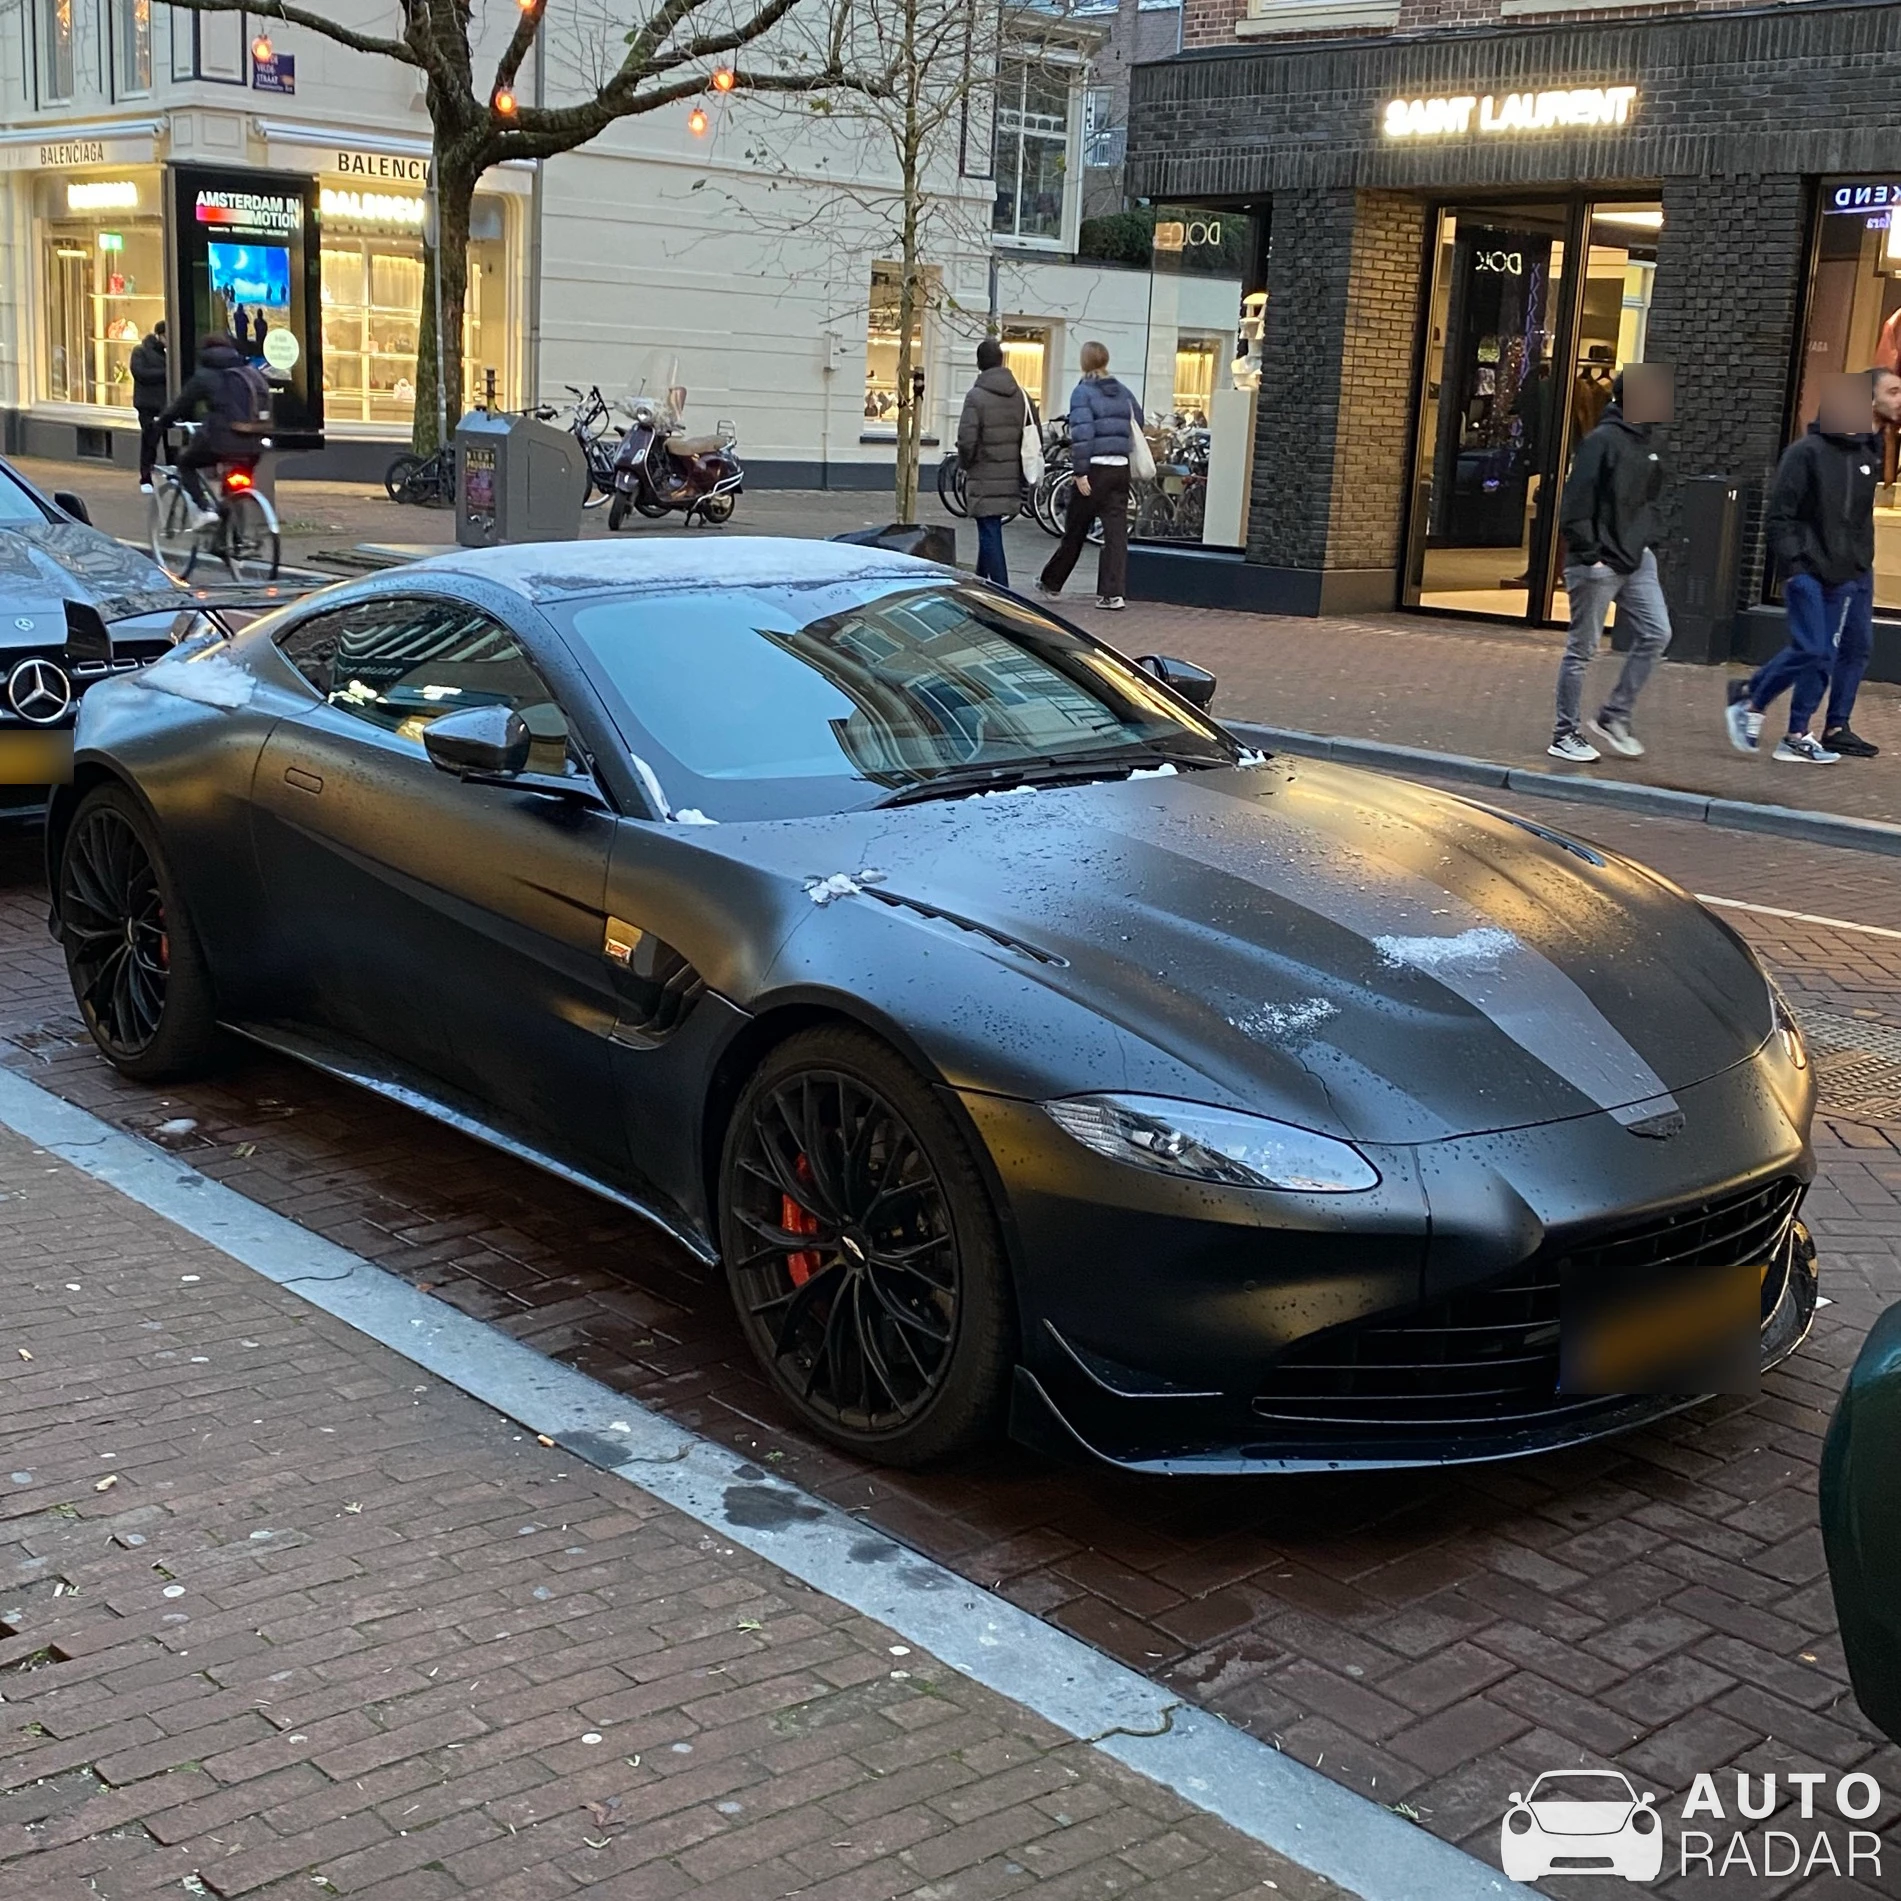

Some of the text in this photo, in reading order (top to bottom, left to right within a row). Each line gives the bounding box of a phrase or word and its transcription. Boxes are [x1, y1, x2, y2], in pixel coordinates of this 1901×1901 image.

[1384, 86, 1637, 136] SAINT LAURENT
[40, 142, 104, 165] BALENCIAGA
[338, 152, 428, 181] BALENCI
[196, 190, 300, 213] AMSTERDAM IN
[252, 210, 300, 229] MOTION
